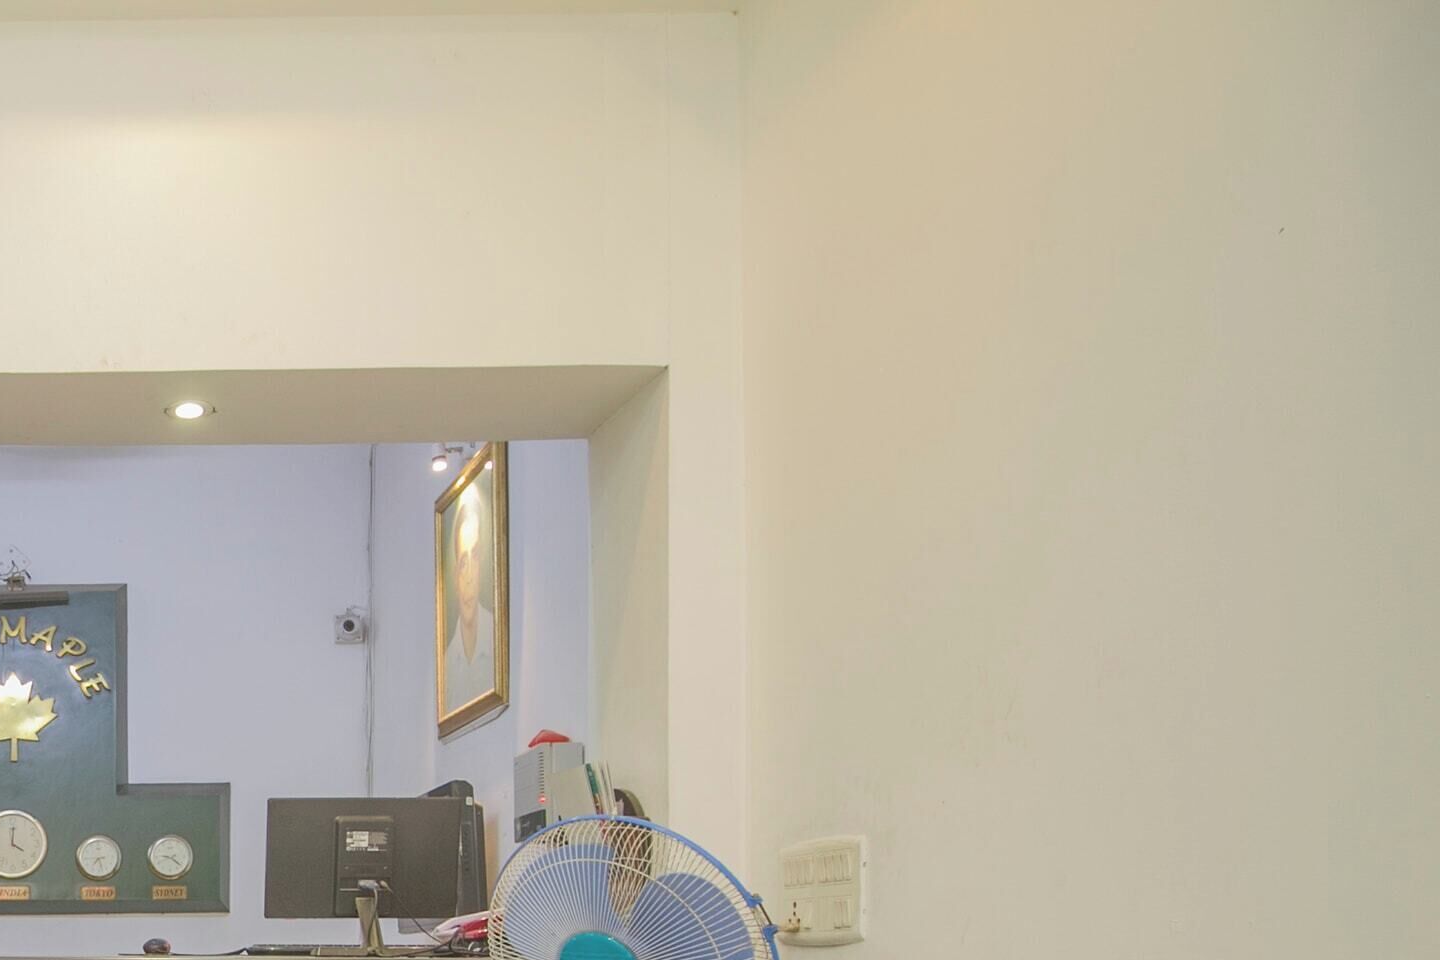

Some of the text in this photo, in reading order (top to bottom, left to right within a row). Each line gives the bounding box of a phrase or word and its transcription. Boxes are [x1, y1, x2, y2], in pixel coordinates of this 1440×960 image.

[0, 615, 111, 700] MAPLE
[85, 887, 114, 898] TOKYO
[154, 887, 185, 898] SYDNEY
